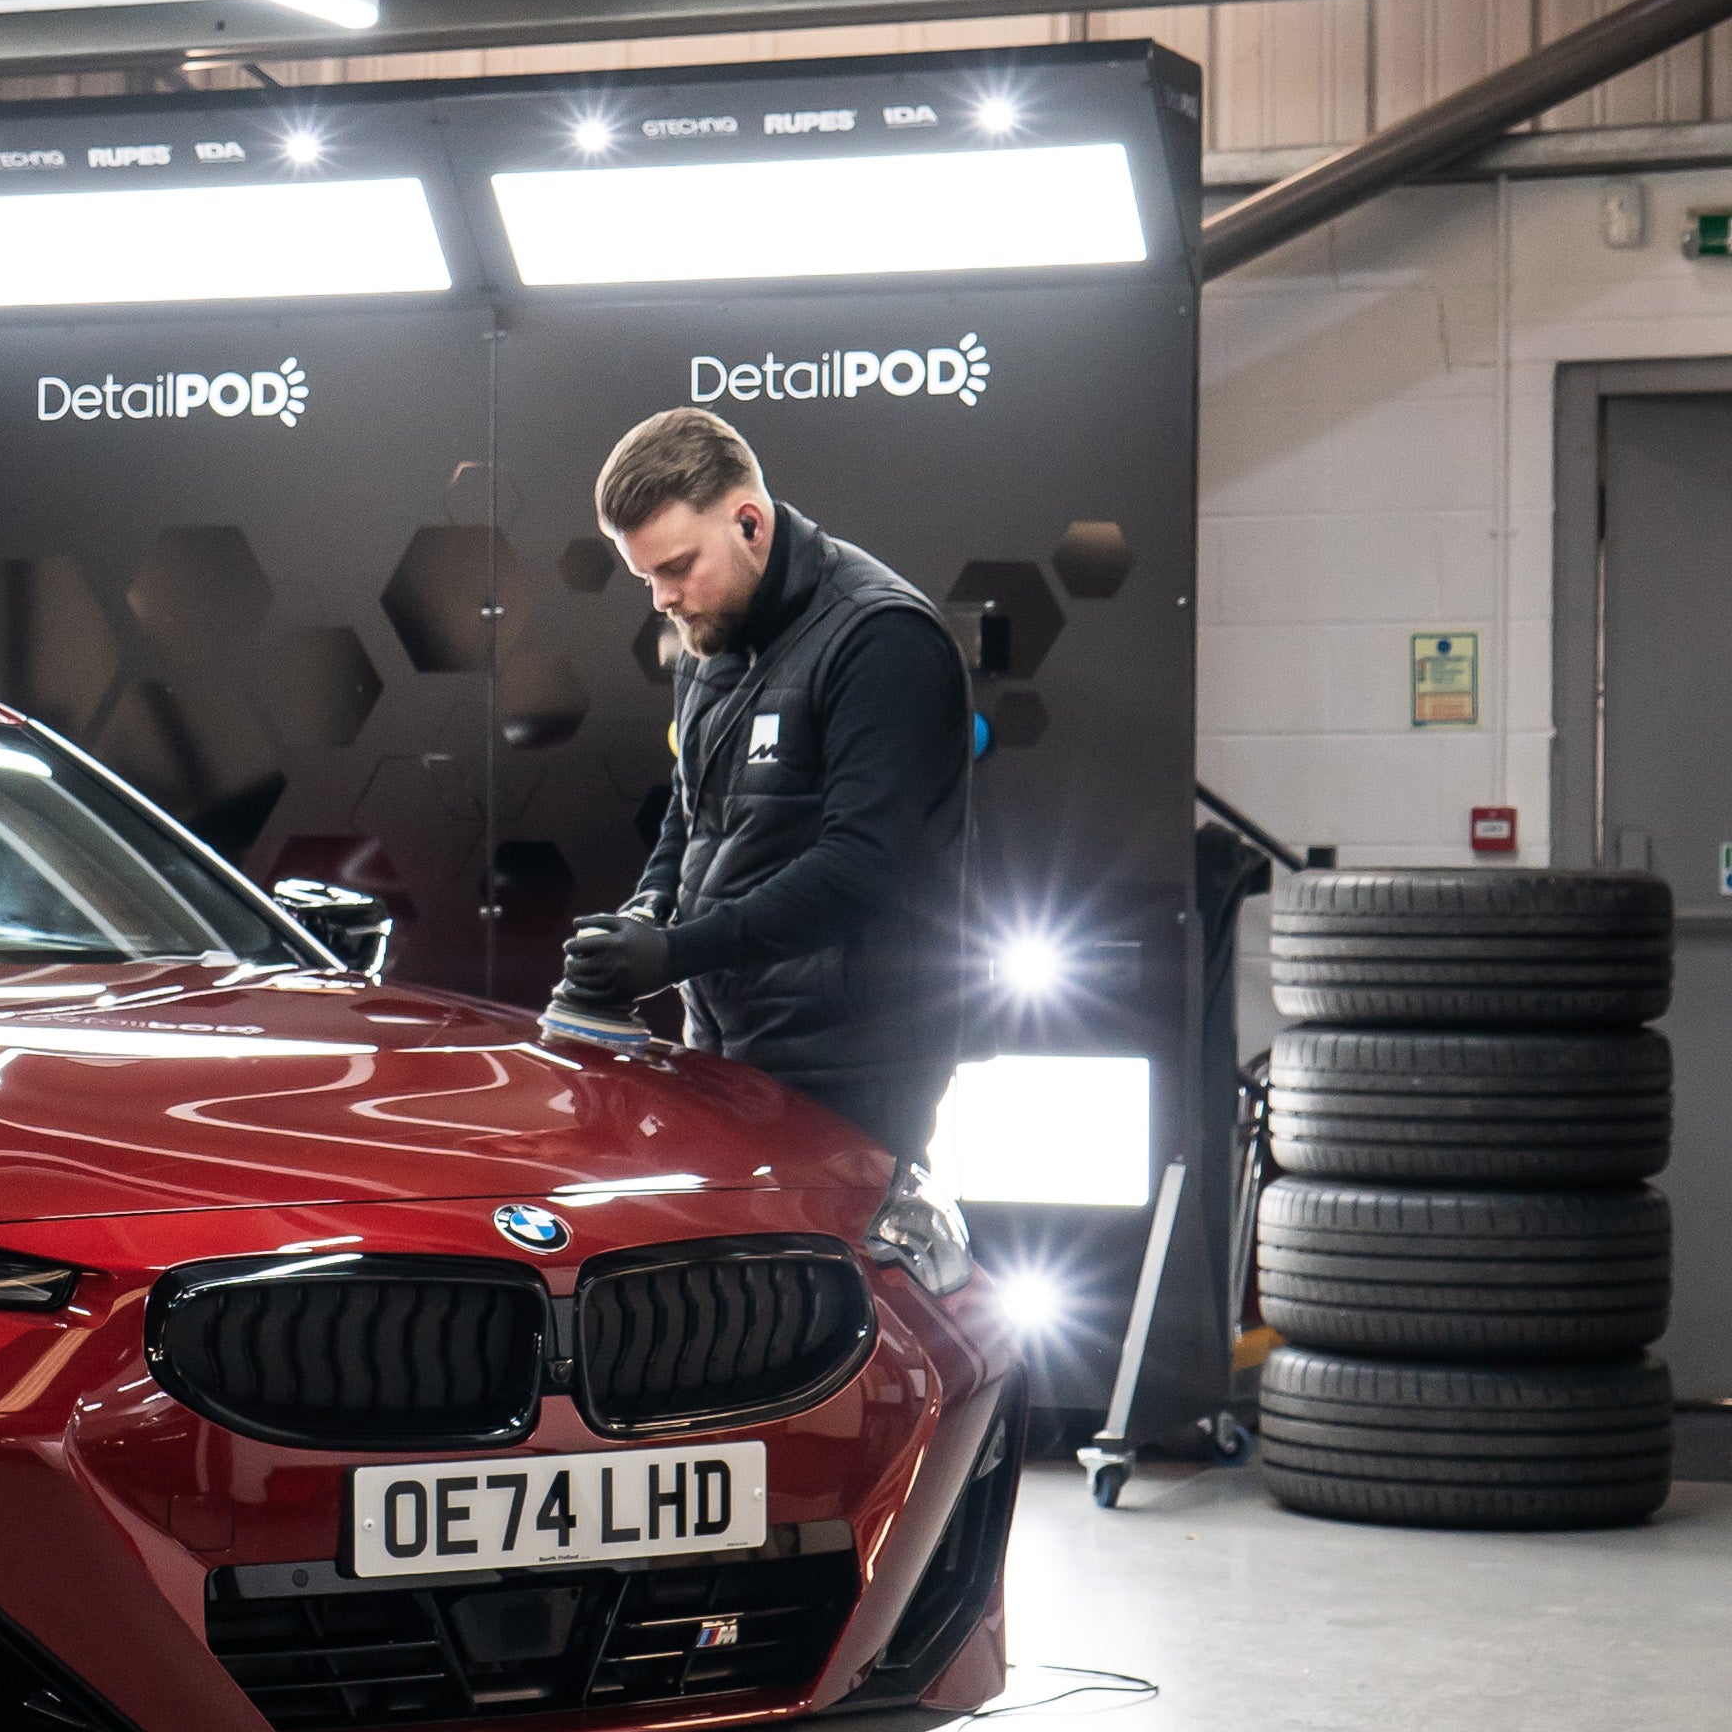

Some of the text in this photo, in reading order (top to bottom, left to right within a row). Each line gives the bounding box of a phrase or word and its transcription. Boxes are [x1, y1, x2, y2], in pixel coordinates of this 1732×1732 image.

[763, 110, 856, 135] RUPES
[87, 144, 171, 168] RUPES
[36, 371, 290, 423] DetailPOD
[690, 346, 966, 405] DetailPOD
[383, 1458, 732, 1558] OE74 LHD
